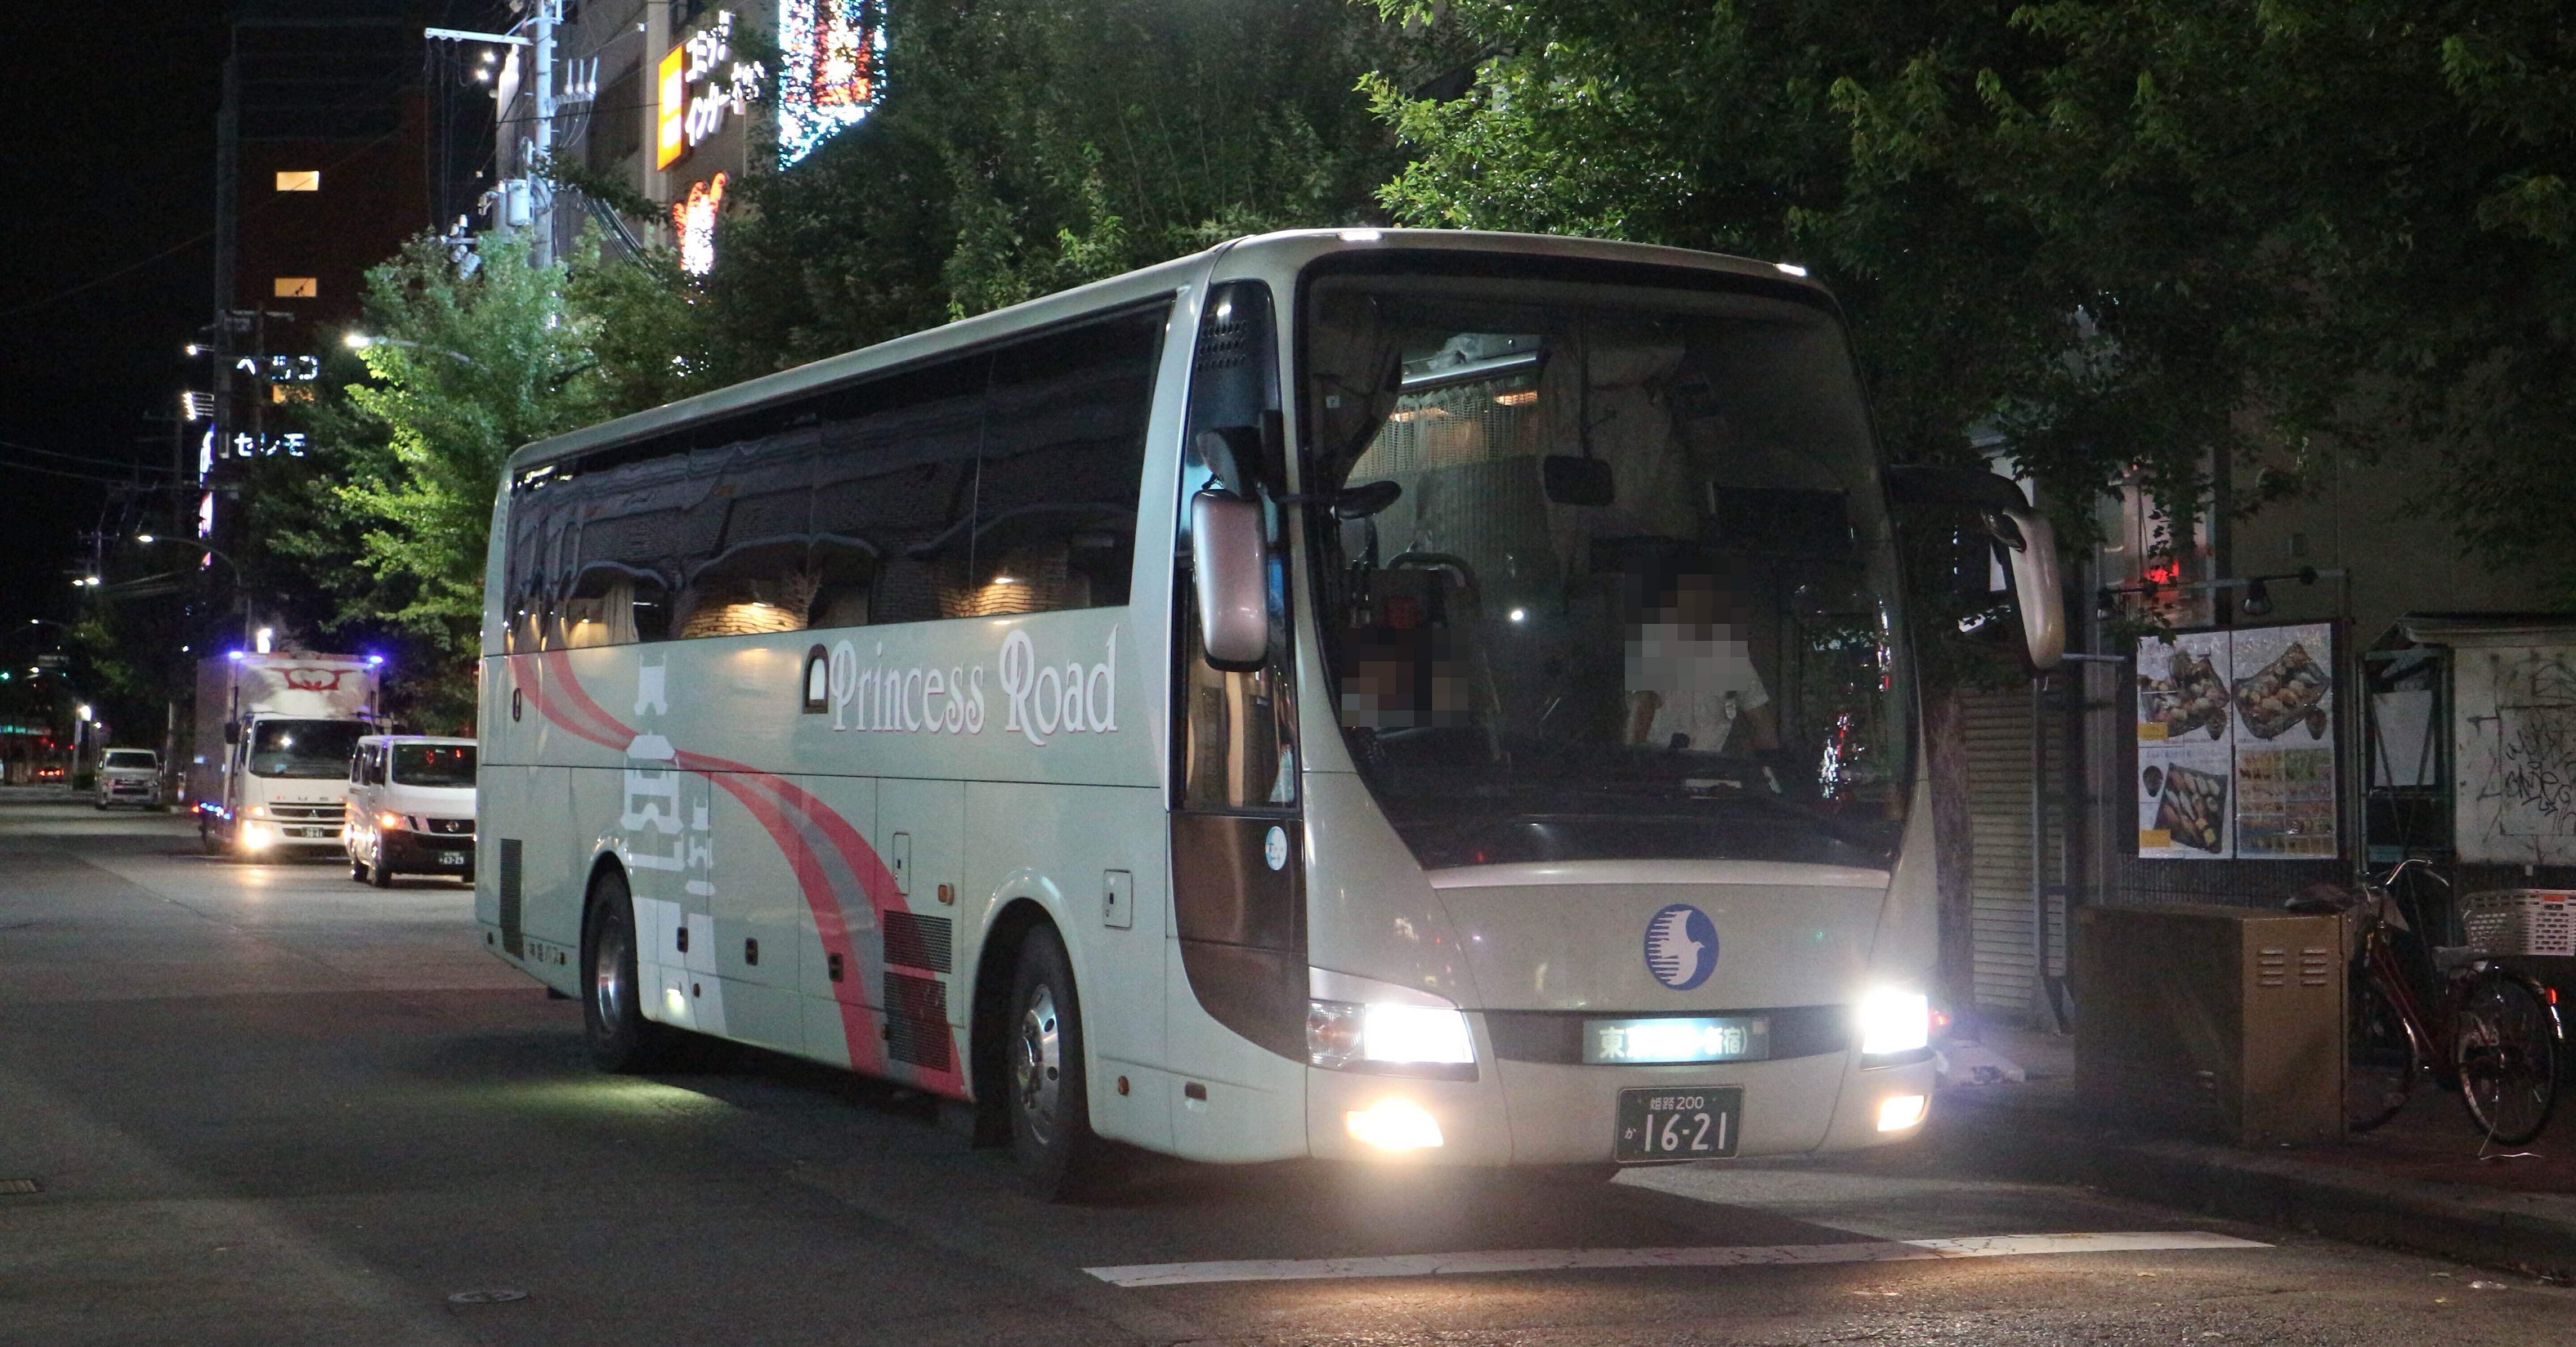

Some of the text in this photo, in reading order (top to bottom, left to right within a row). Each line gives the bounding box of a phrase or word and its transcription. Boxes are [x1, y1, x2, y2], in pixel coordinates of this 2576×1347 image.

[829, 623, 1119, 746] Princess Road
[1644, 1111, 1727, 1152] 16-21
